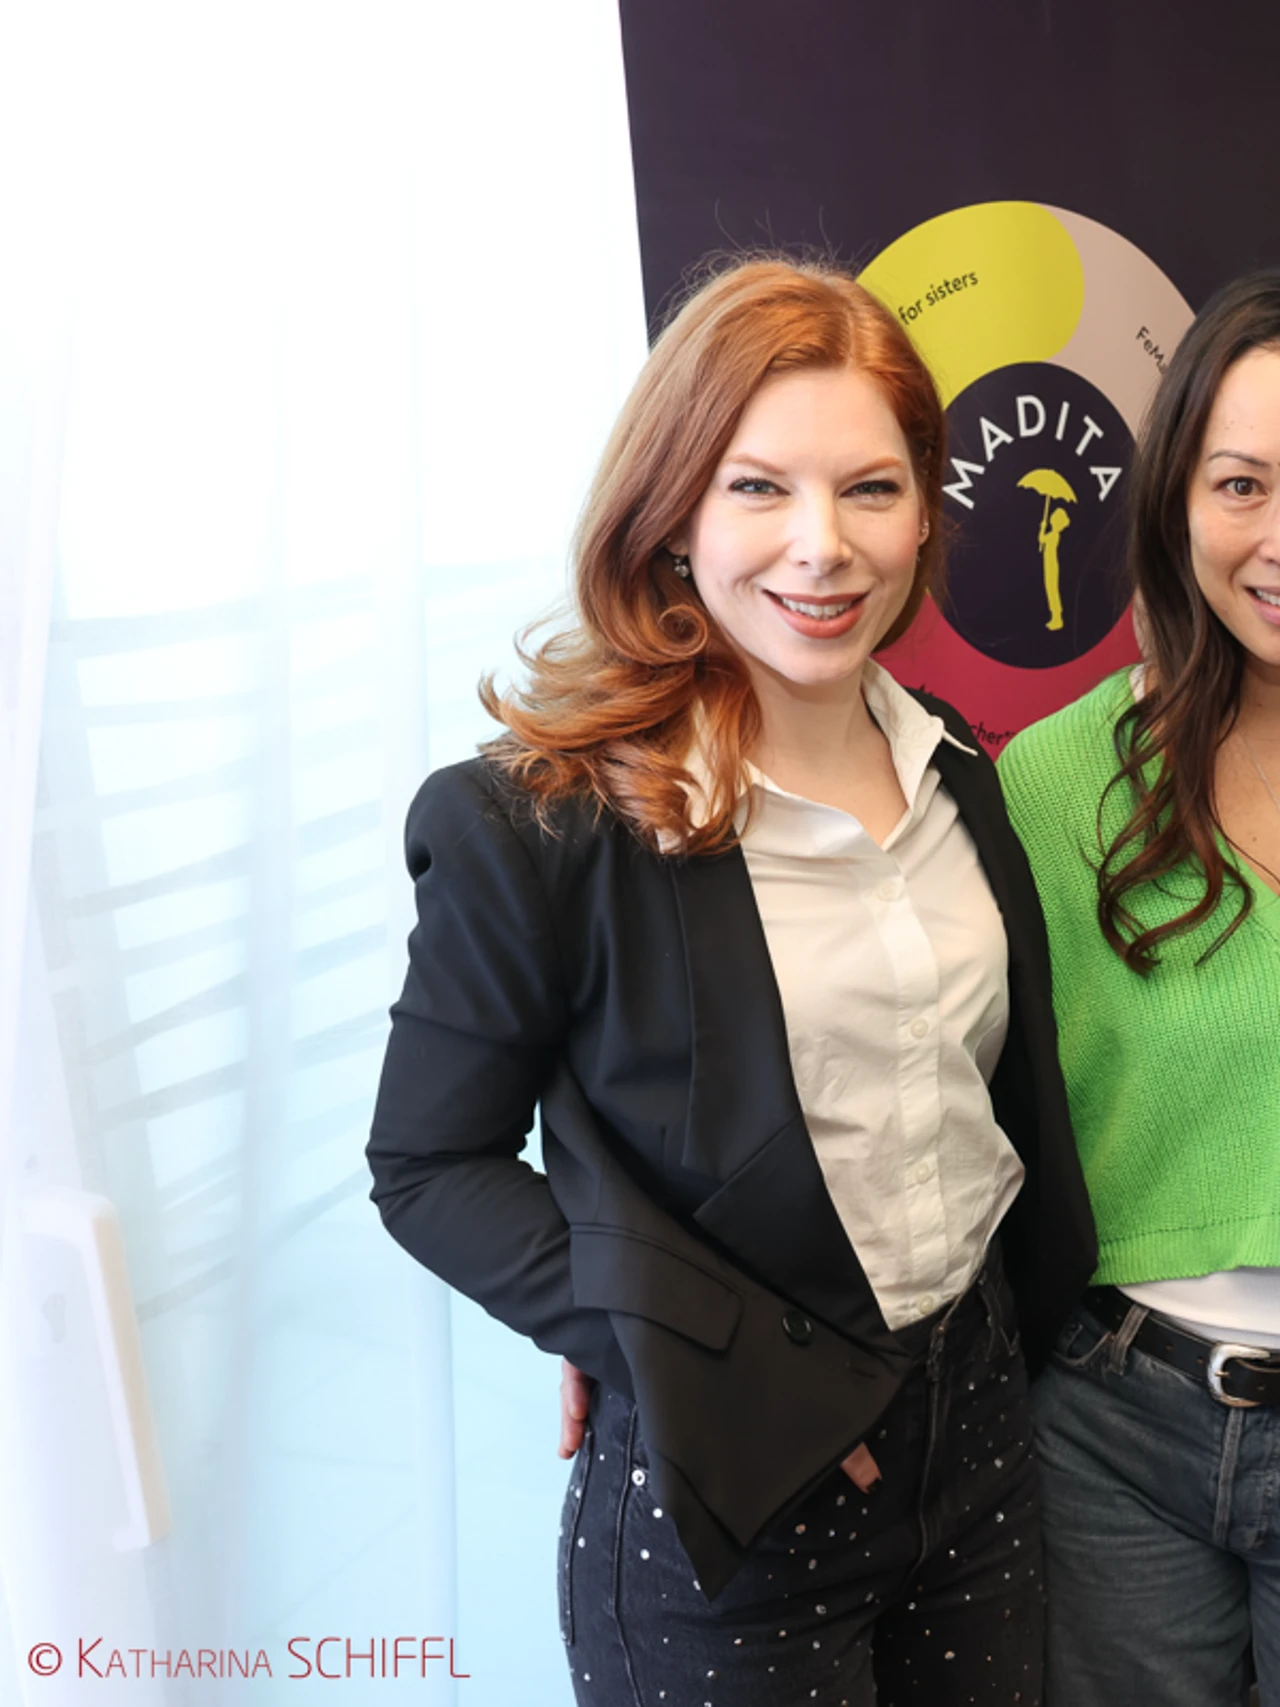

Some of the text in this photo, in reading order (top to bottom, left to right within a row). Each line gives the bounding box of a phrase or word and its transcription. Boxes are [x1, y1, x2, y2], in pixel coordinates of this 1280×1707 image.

[898, 271, 979, 326] for sisters
[941, 394, 1123, 510] MADITA
